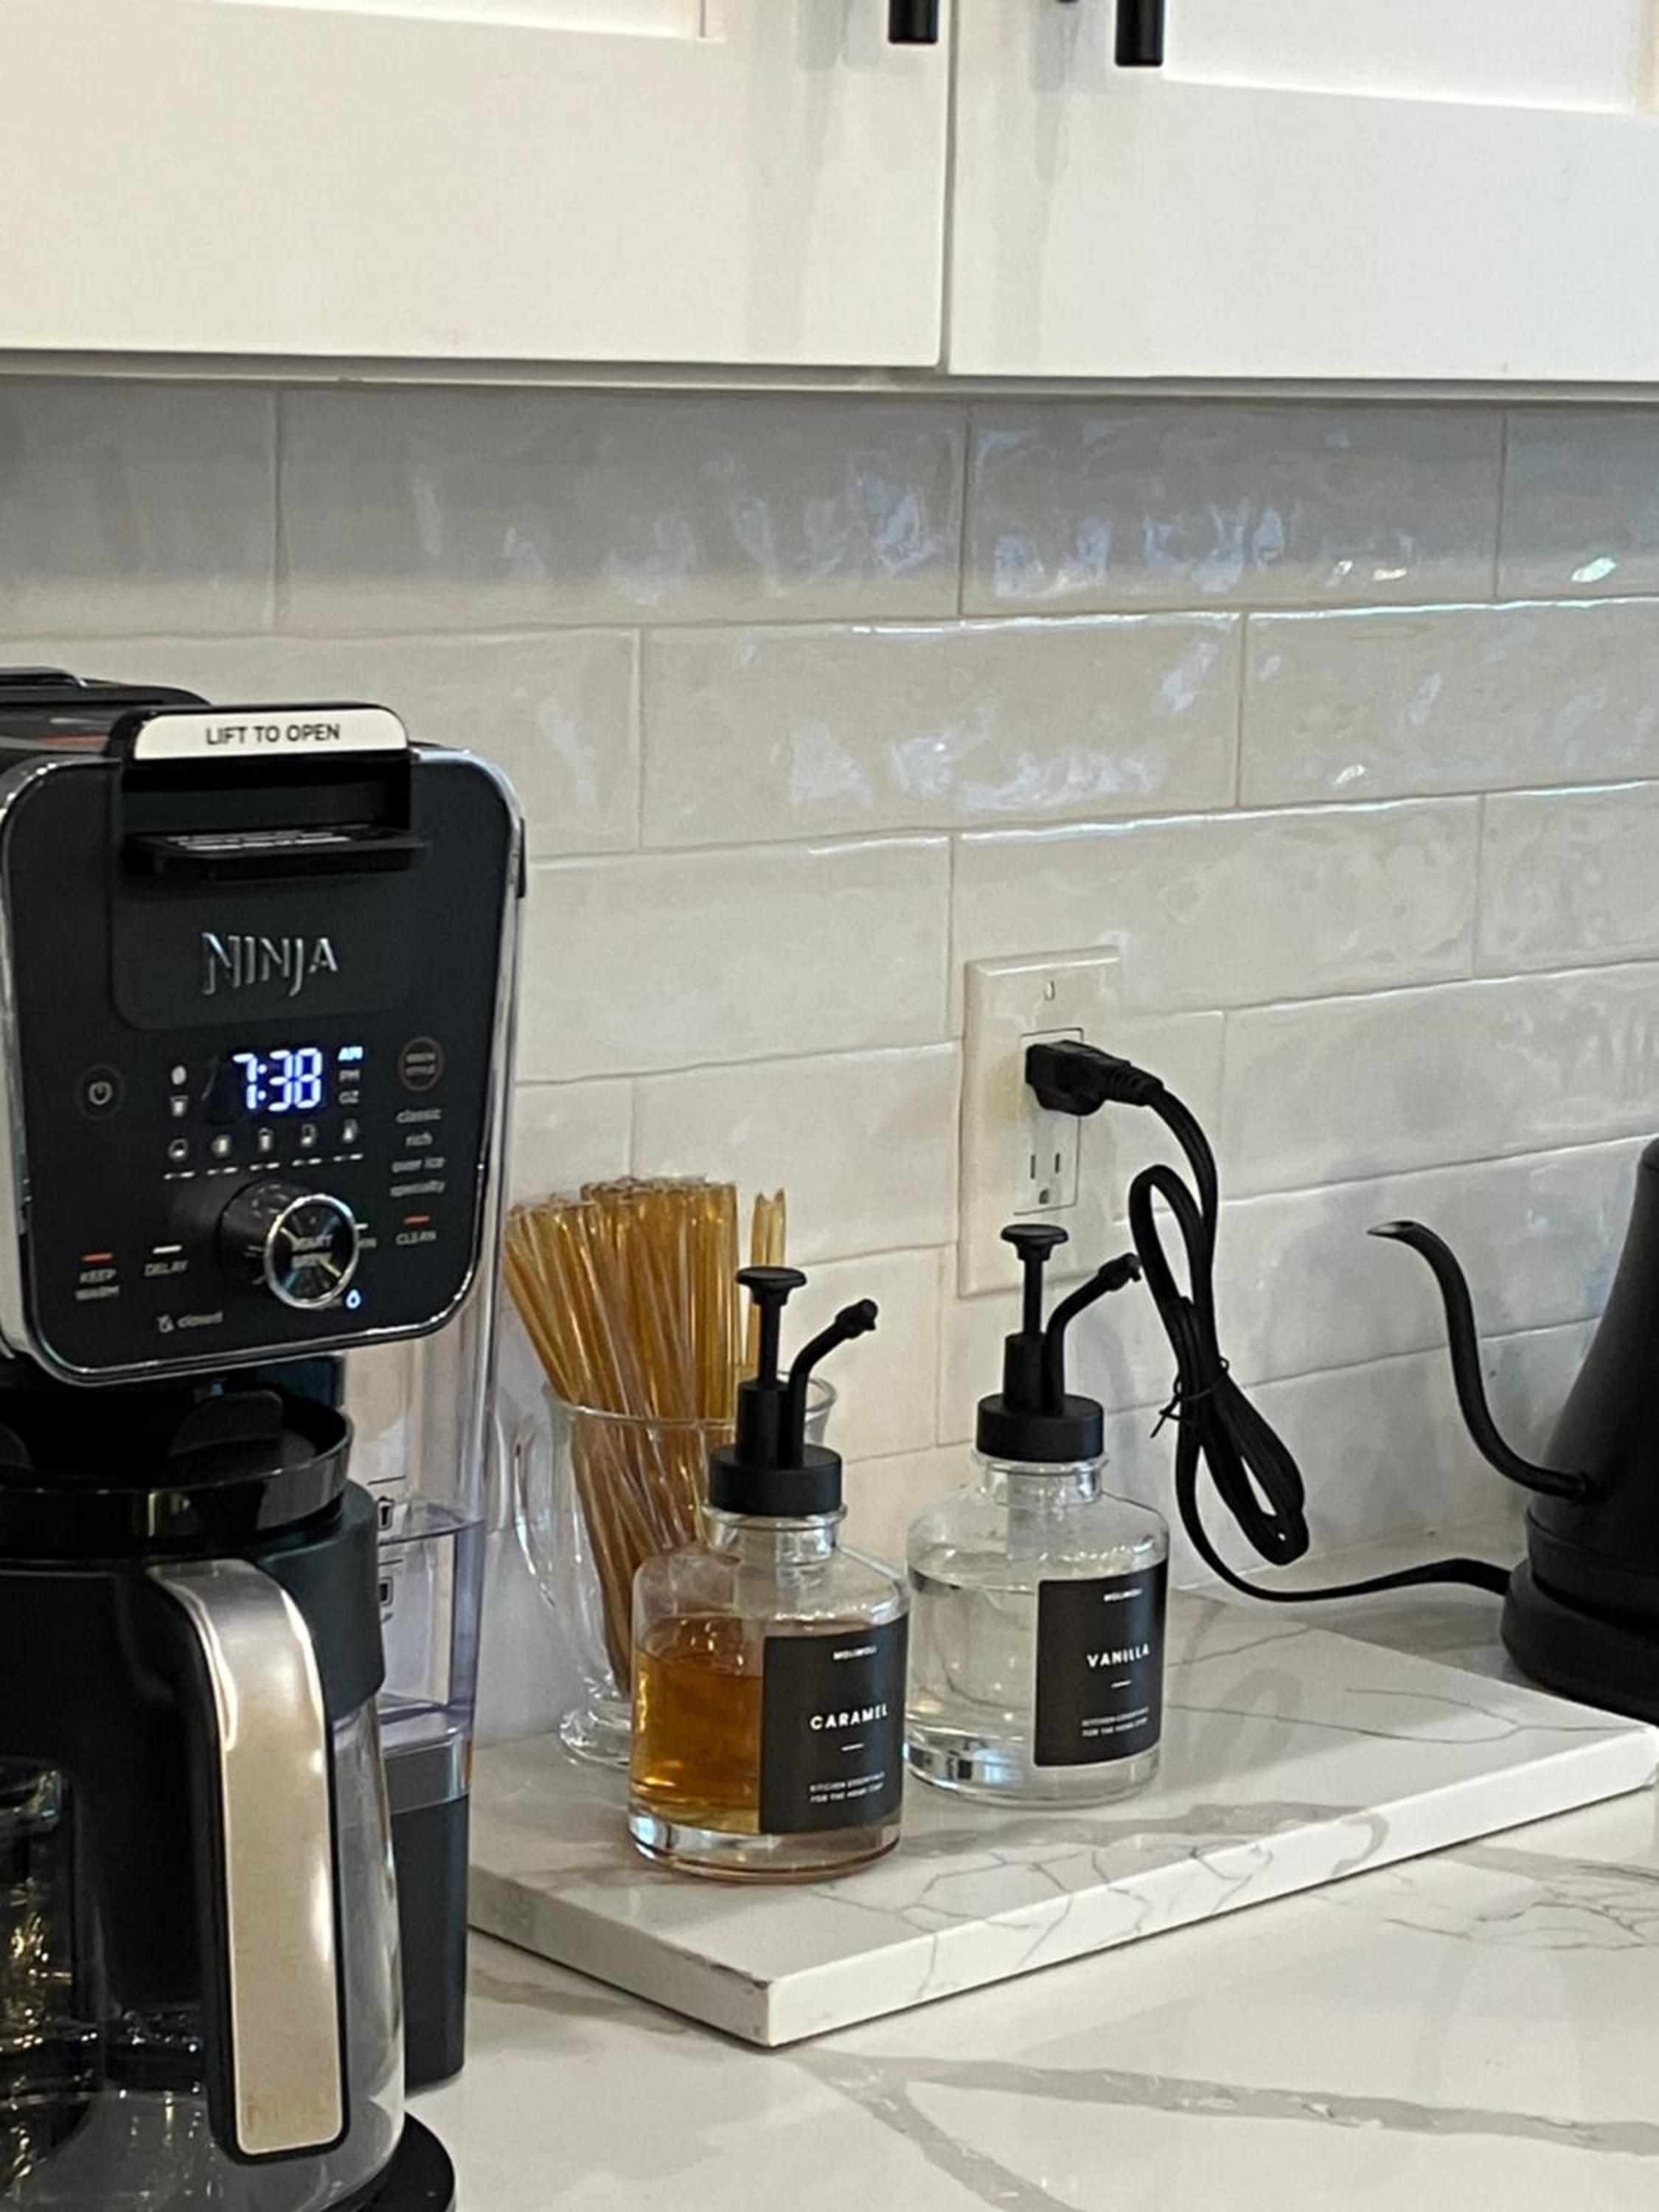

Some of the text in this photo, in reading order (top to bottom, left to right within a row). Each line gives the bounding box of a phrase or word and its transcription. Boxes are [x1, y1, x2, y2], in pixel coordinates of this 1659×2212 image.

[206, 723, 340, 745] LIFT TO OPEN
[202, 932, 338, 997] NINJA
[338, 1046, 363, 1060] AM
[232, 1047, 323, 1112] 7:38
[395, 1231, 437, 1245] CLEAN
[80, 1268, 116, 1284] KEEP
[144, 1260, 187, 1277] DELAY
[1086, 1643, 1150, 1668] VANILLA
[810, 1703, 887, 1731] CARAMEL
